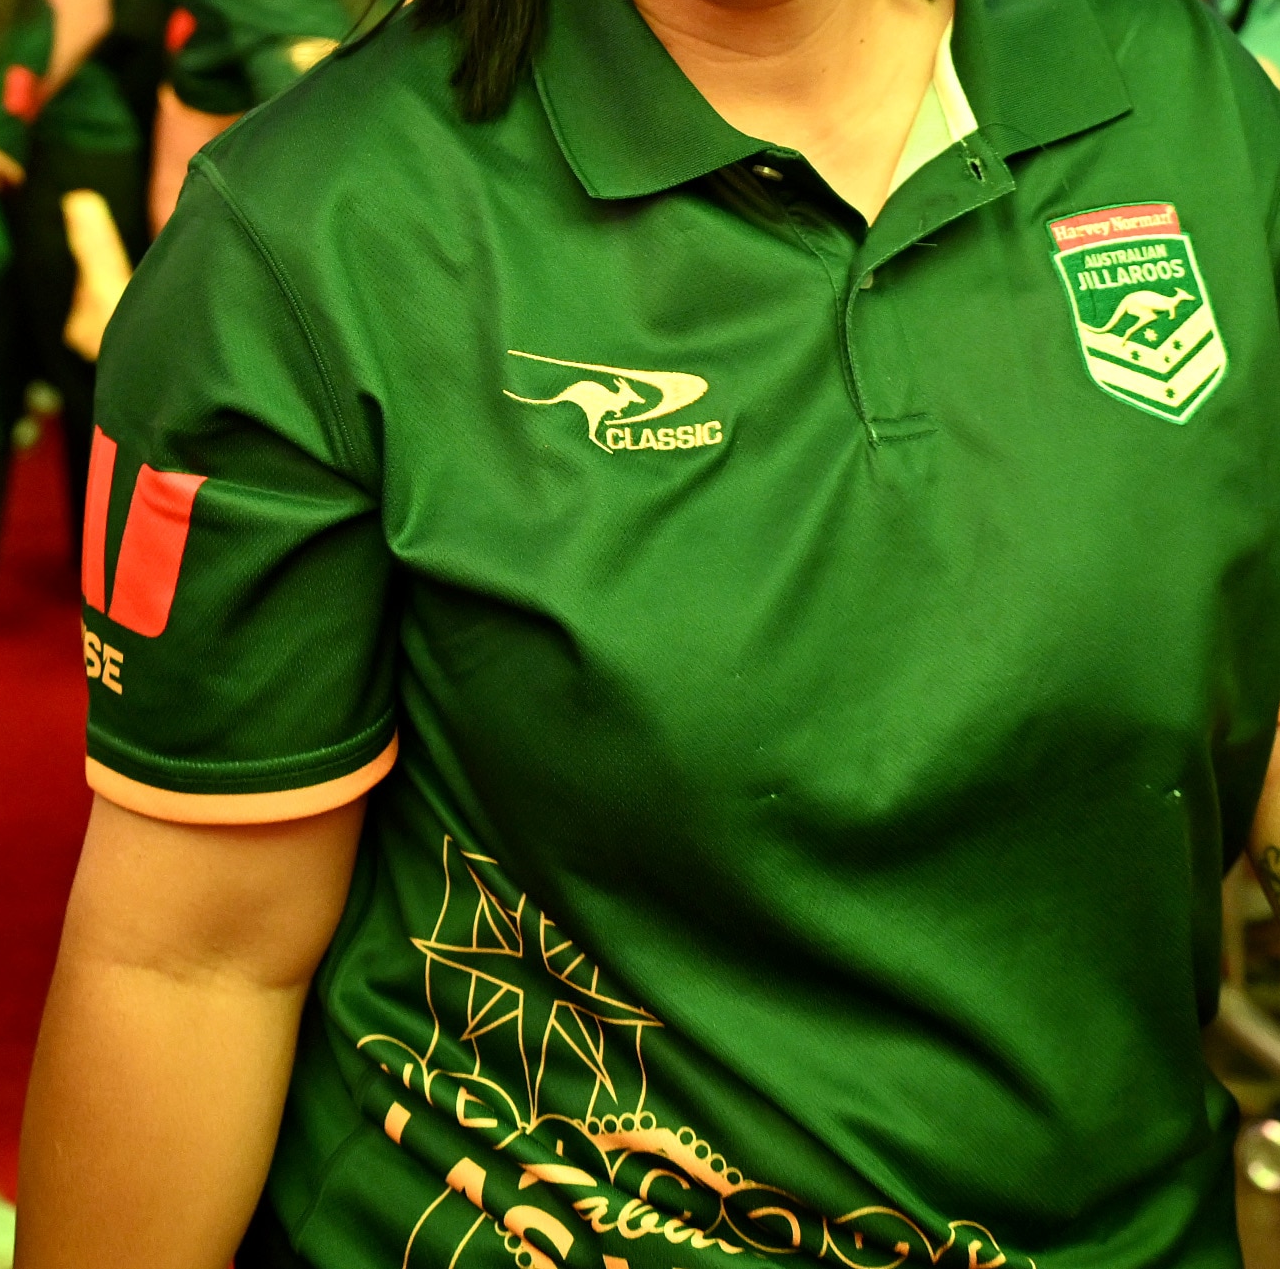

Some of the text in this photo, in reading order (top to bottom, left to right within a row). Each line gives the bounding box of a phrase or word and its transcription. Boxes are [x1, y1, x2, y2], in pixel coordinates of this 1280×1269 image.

[1053, 221, 1110, 241] Harvey
[1085, 244, 1168, 268] AUSTRALIAN
[1076, 258, 1186, 291] JILLAROOS
[605, 420, 723, 451] CLASSIC
[82, 623, 124, 696] SE
